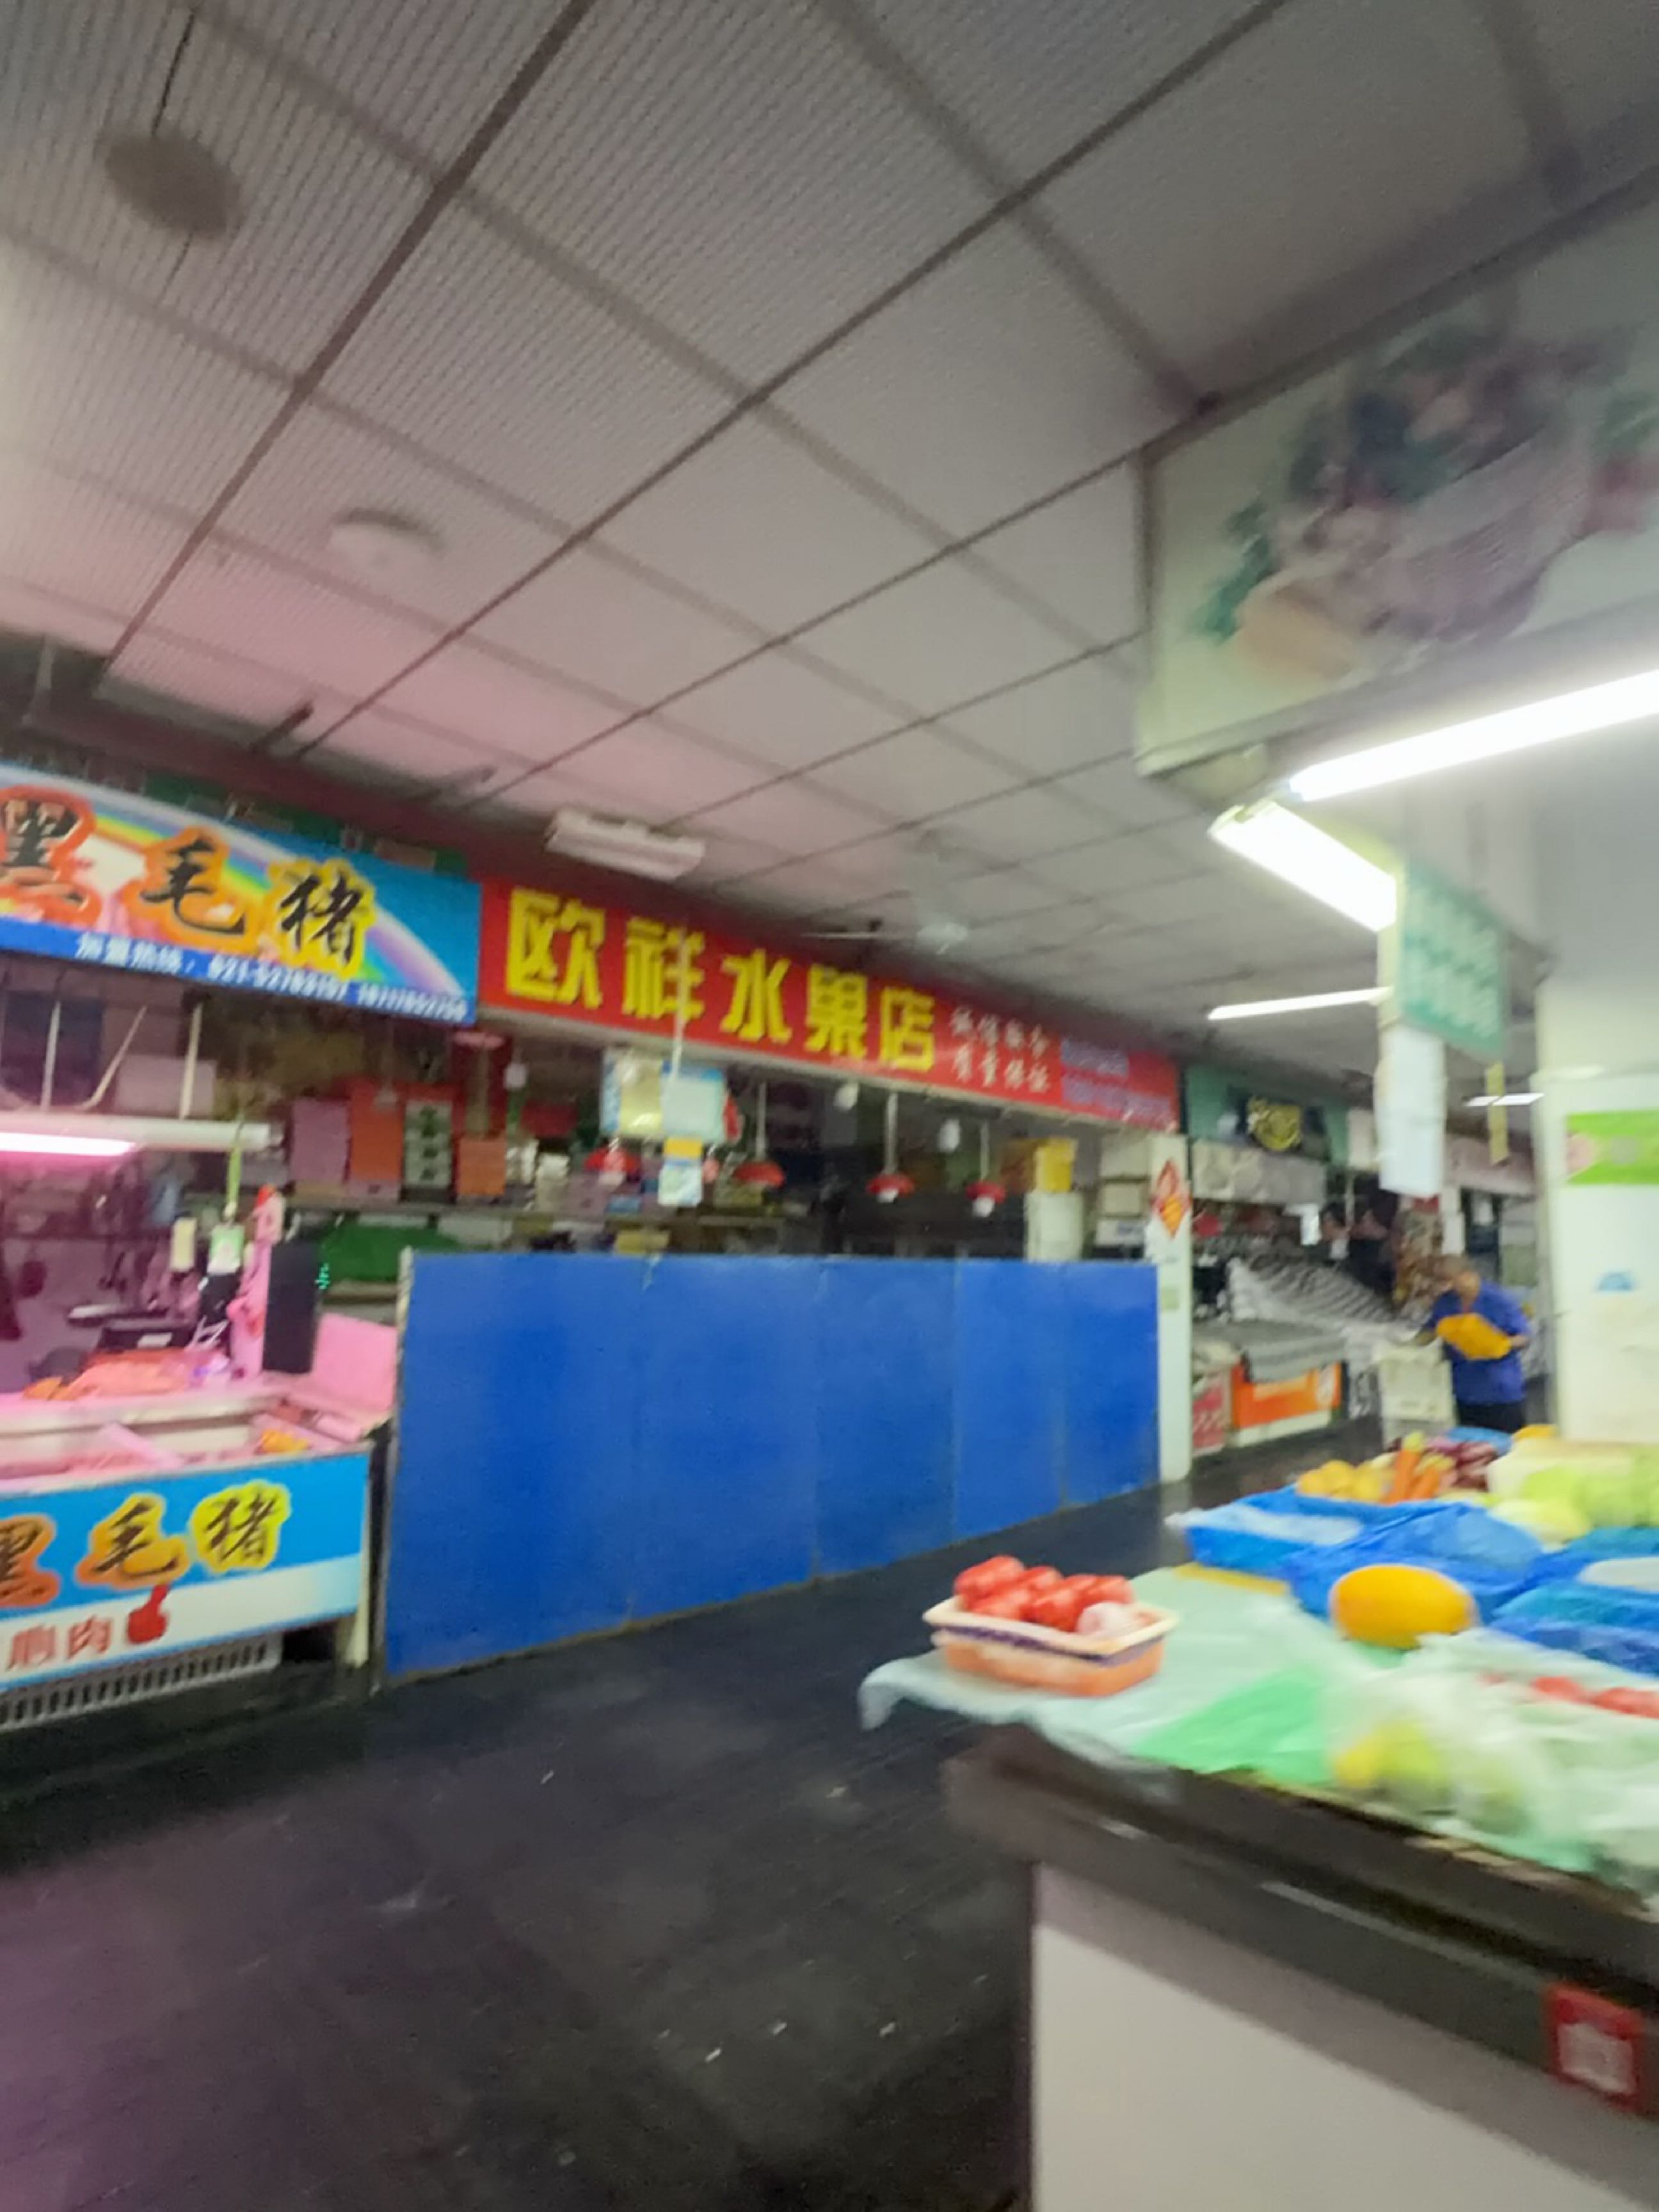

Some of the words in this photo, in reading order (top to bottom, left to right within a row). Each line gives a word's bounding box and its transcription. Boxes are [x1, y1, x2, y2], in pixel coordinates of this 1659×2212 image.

[504, 886, 936, 1073] 欧祥水果店
